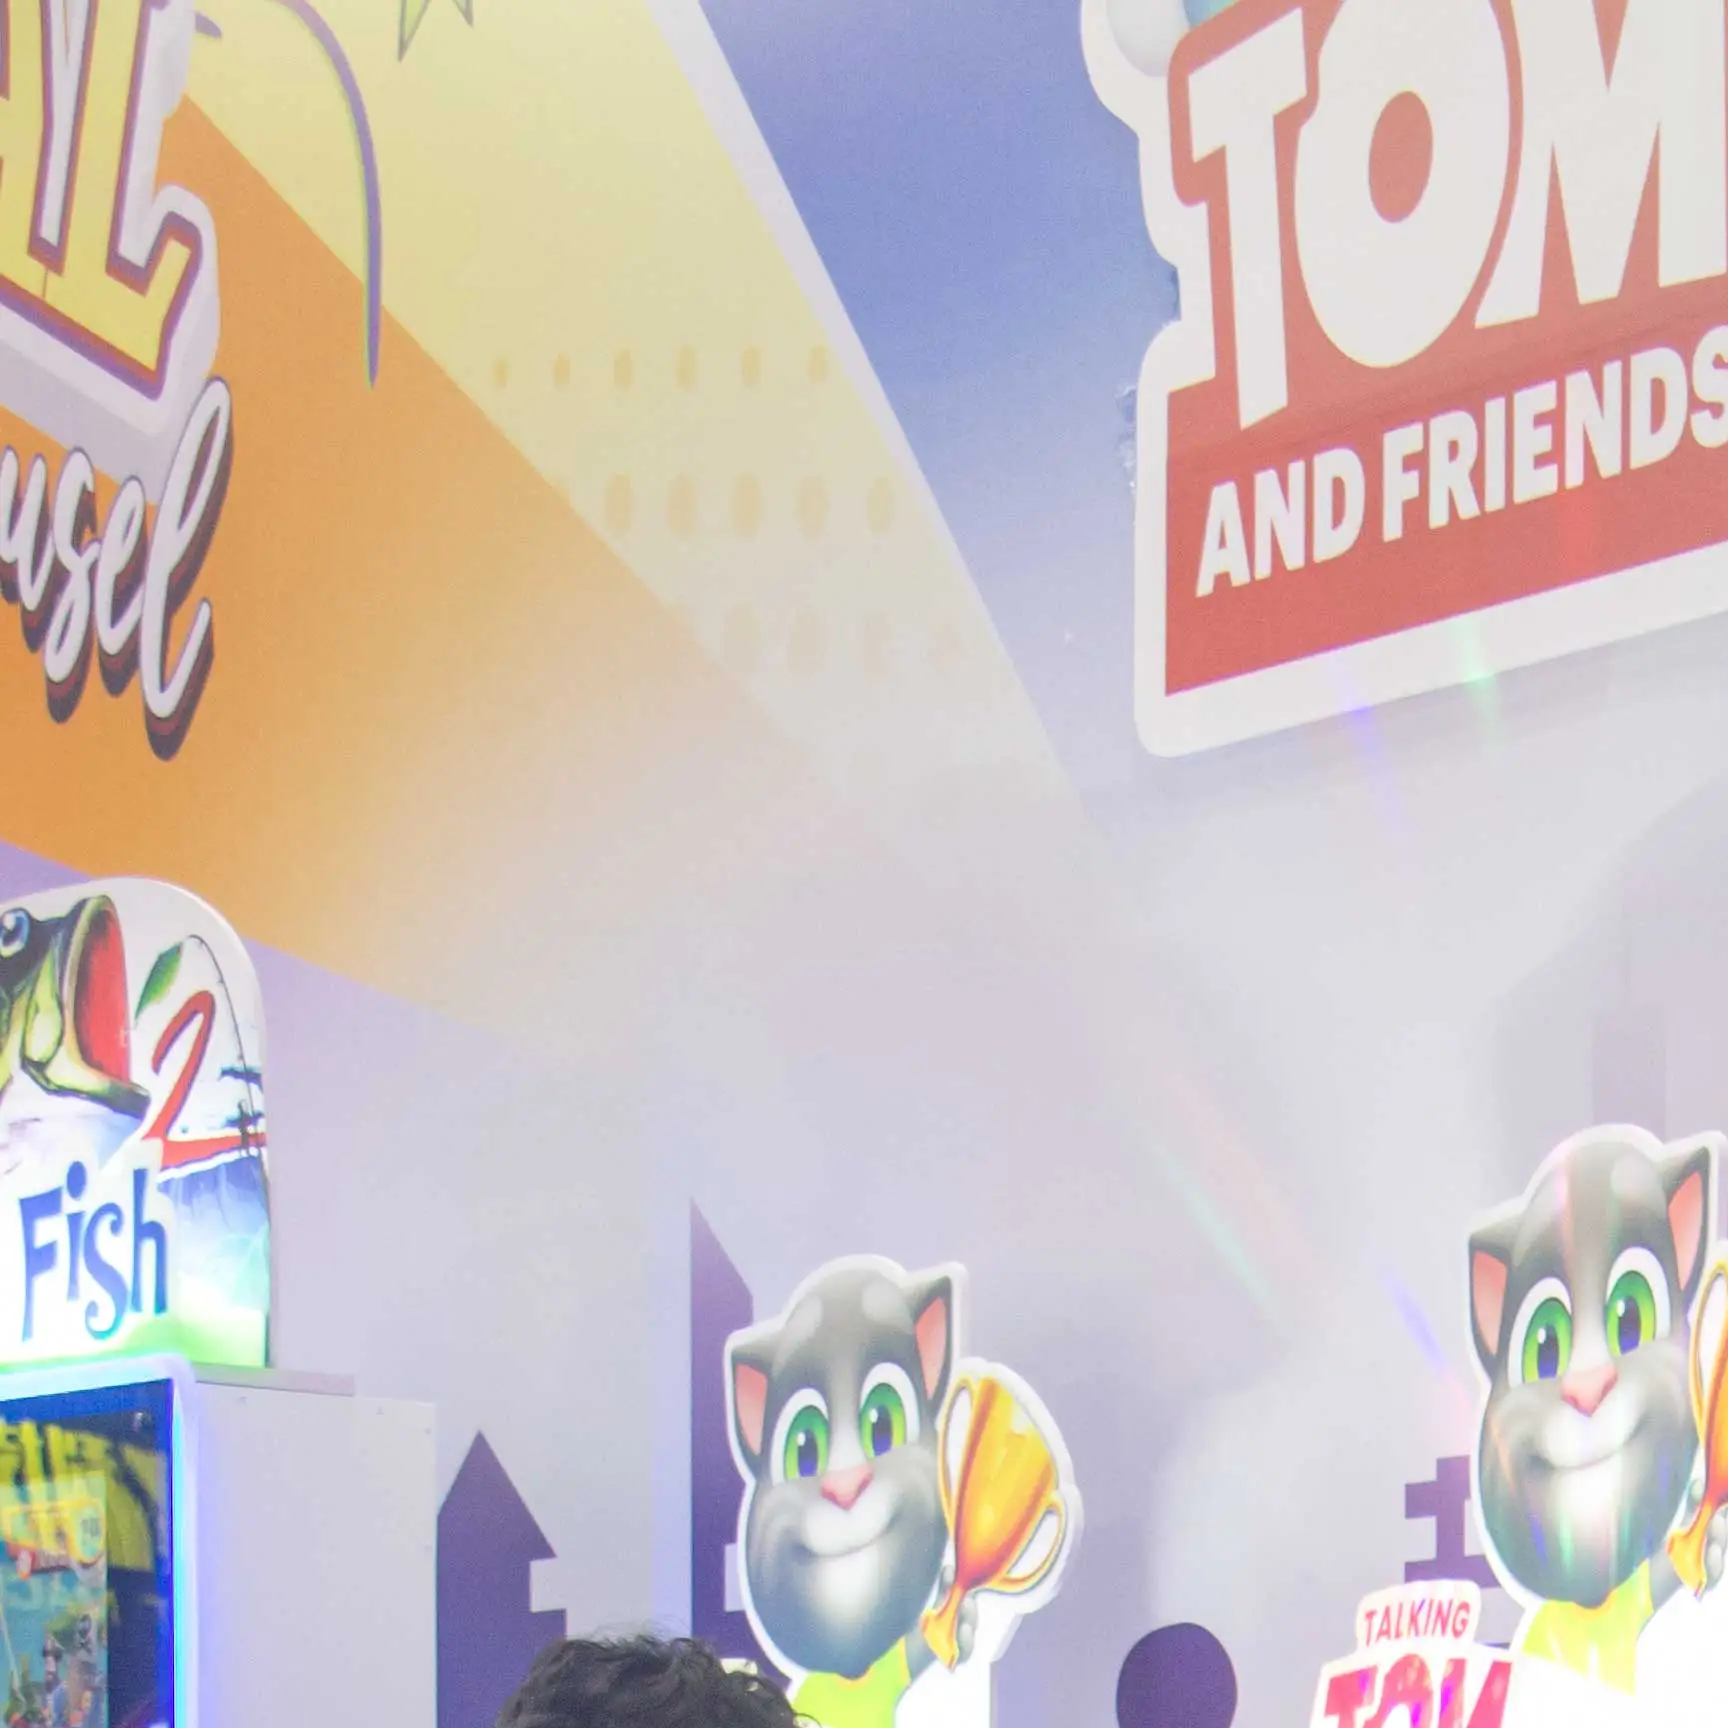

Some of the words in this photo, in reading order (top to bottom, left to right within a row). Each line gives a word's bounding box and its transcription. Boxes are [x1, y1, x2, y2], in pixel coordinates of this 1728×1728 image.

[1188, 0, 1727, 429] TOM
[1196, 448, 1366, 597] AND
[142, 989, 268, 1172] 2
[20, 1160, 168, 1342] Fish
[1363, 1598, 1471, 1641] TALKING
